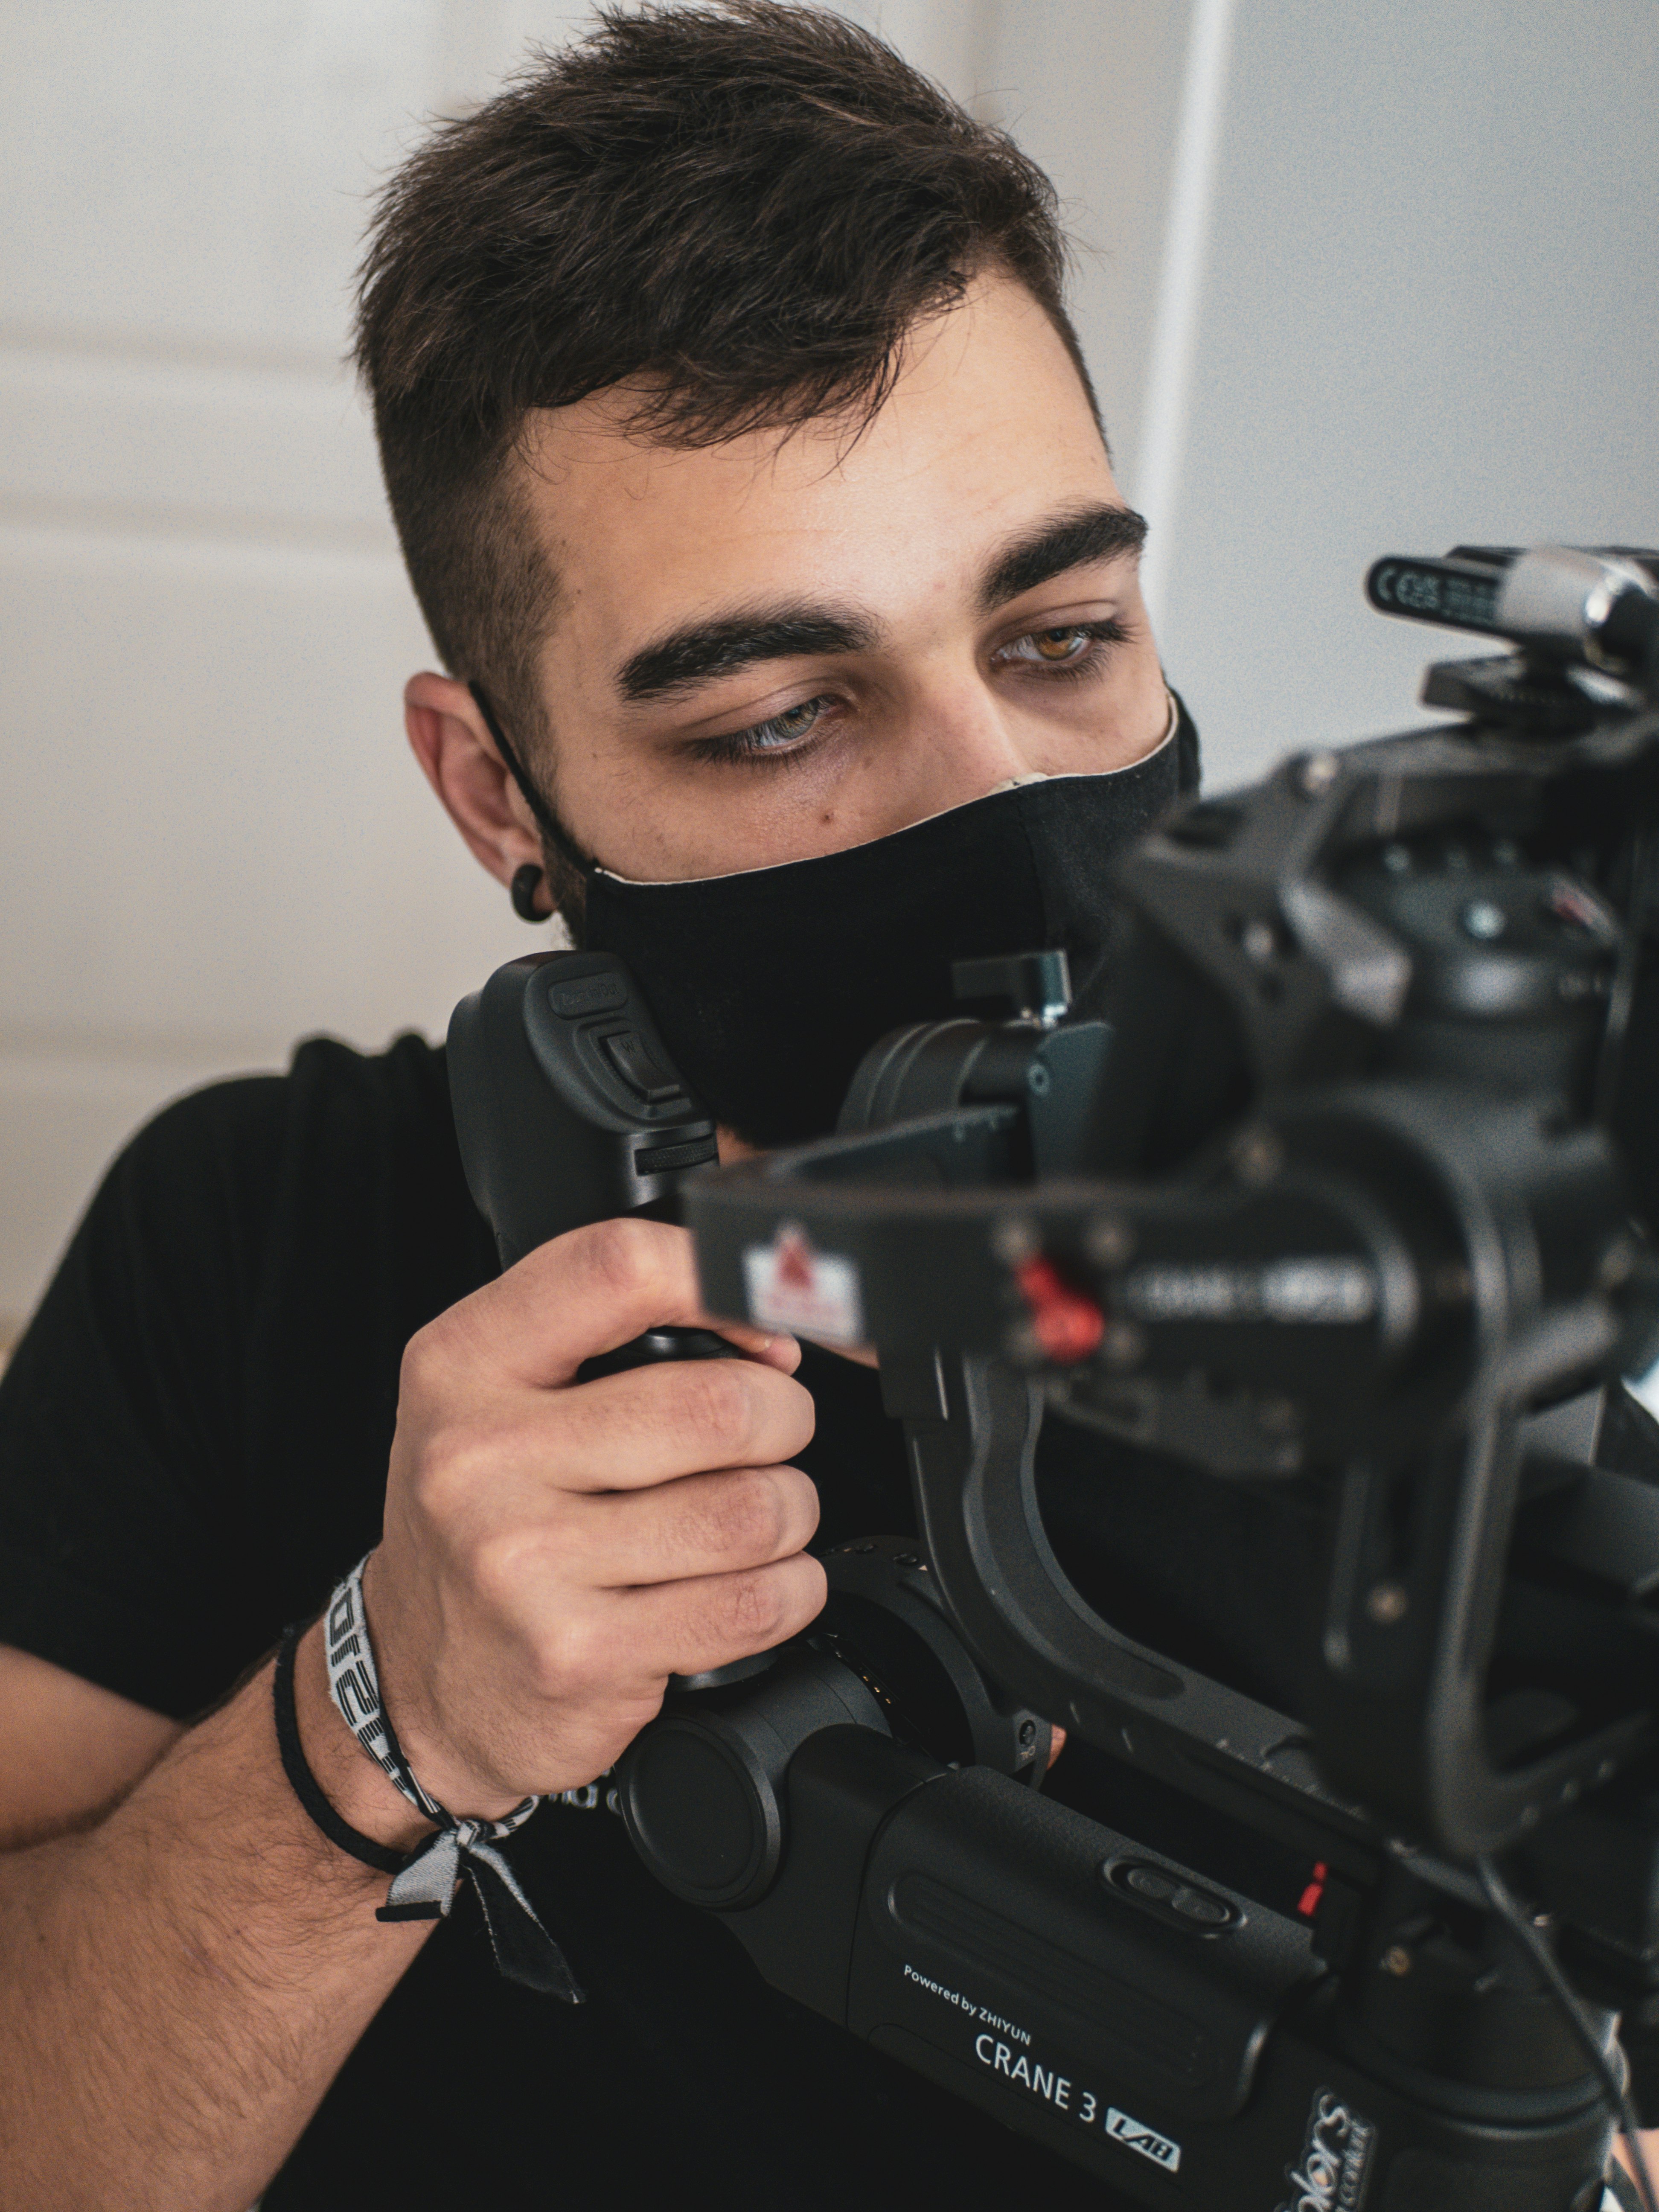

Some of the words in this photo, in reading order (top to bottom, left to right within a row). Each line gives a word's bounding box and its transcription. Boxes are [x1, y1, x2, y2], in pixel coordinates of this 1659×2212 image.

[904, 1964, 960, 2005] Powered
[961, 1996, 977, 2017] by
[979, 2007, 1032, 2046] ZHIYUN
[976, 2034, 1072, 2110] CRANE
[1079, 2091, 1097, 2123] 3
[1111, 2114, 1174, 2162] LAB
